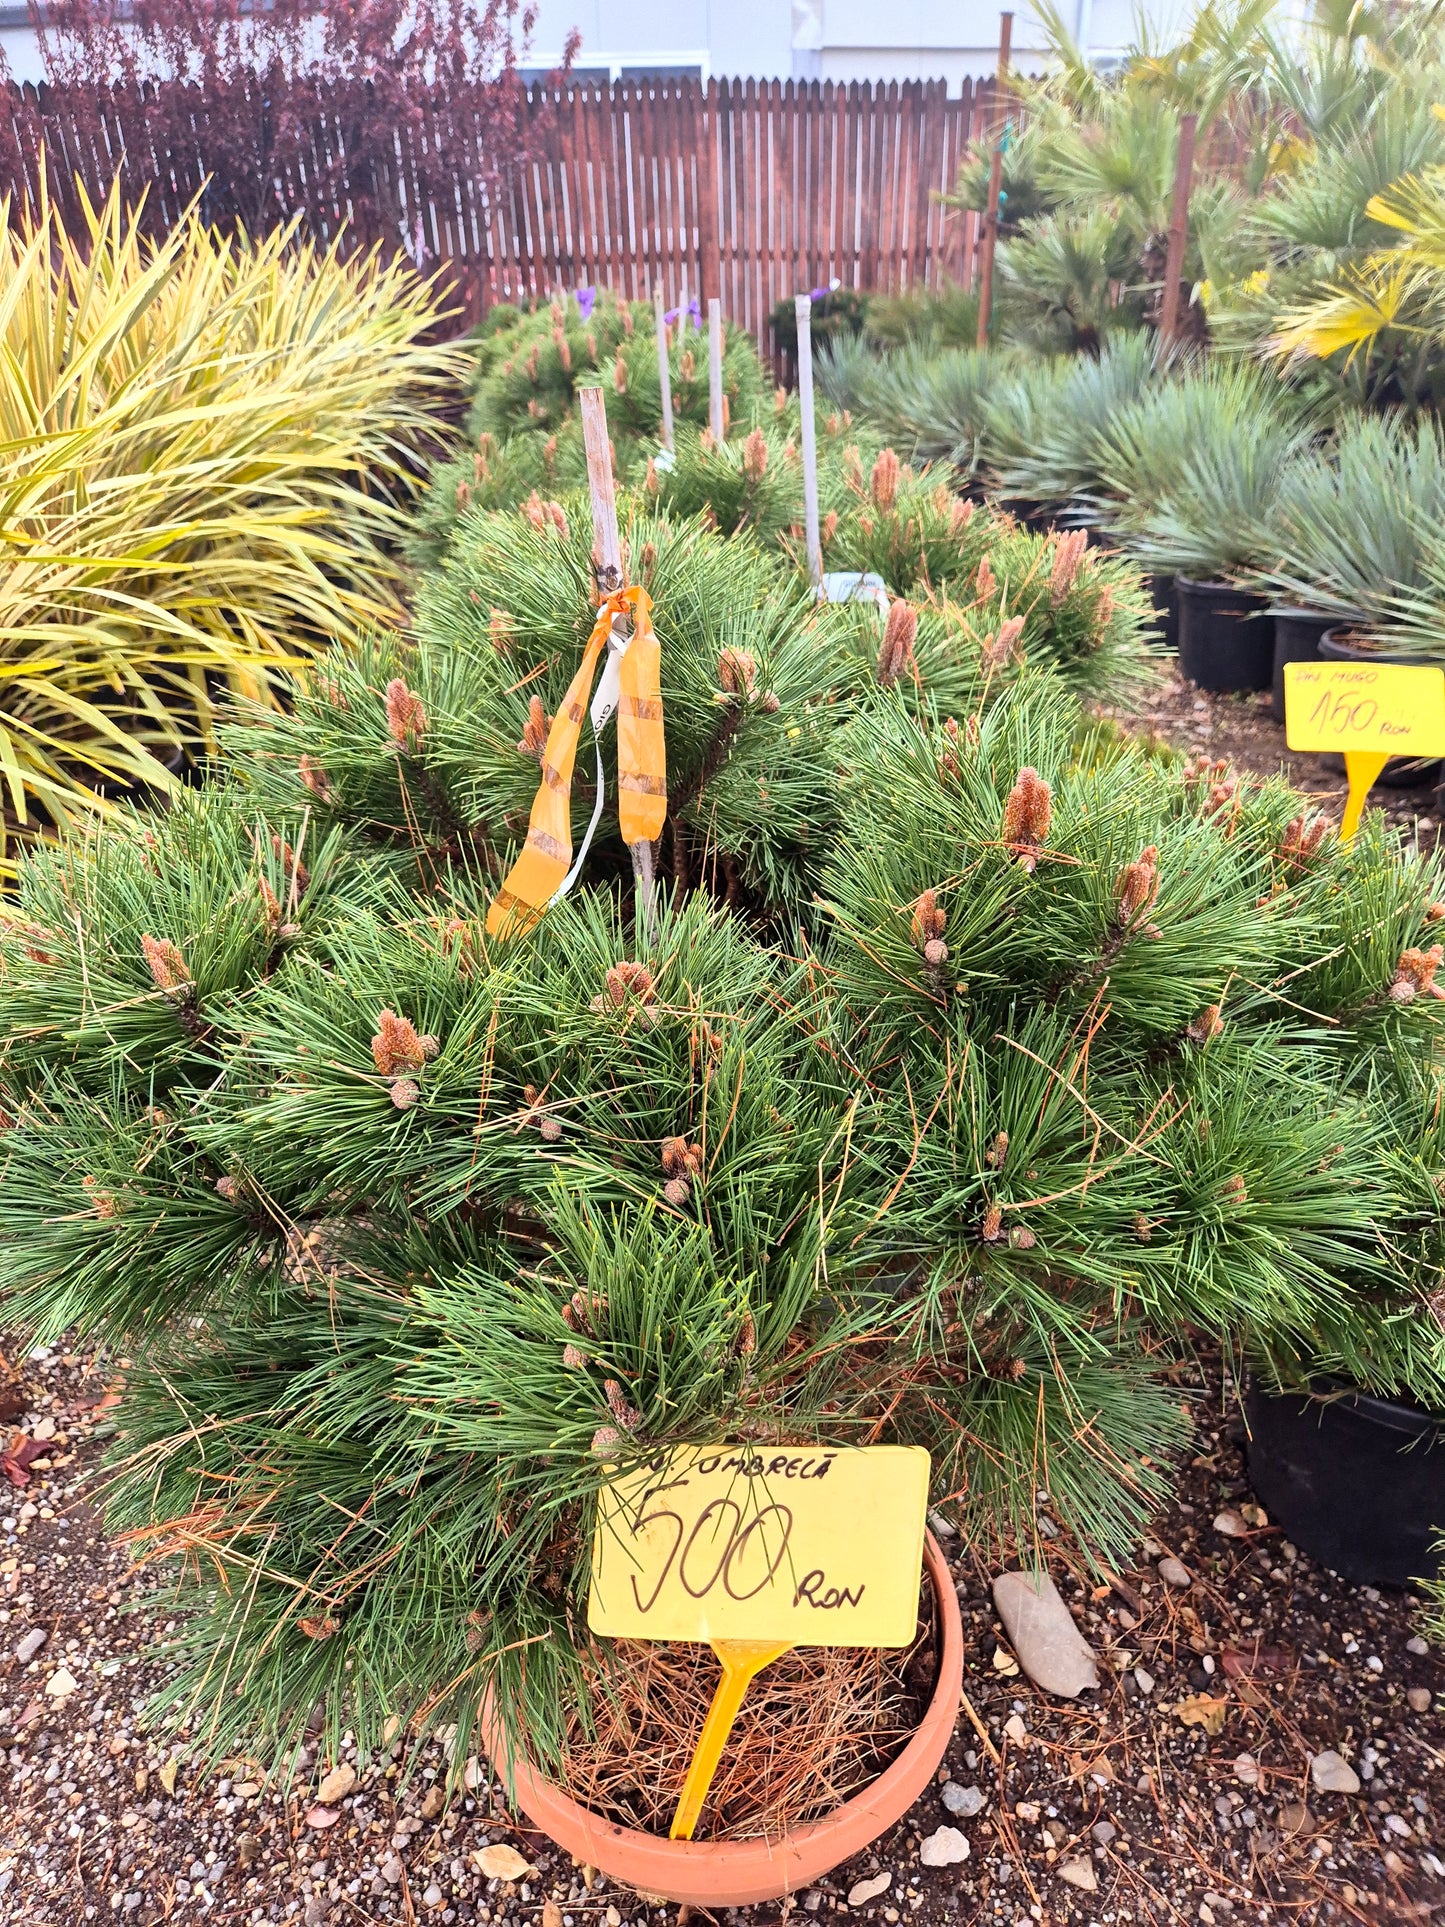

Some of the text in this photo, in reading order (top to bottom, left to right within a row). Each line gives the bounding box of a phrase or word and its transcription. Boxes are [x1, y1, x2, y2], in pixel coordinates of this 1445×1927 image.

[1330, 670, 1379, 684] MUGO
[1310, 690, 1411, 736] 150 RON
[630, 1480, 866, 1613] 500 RON
